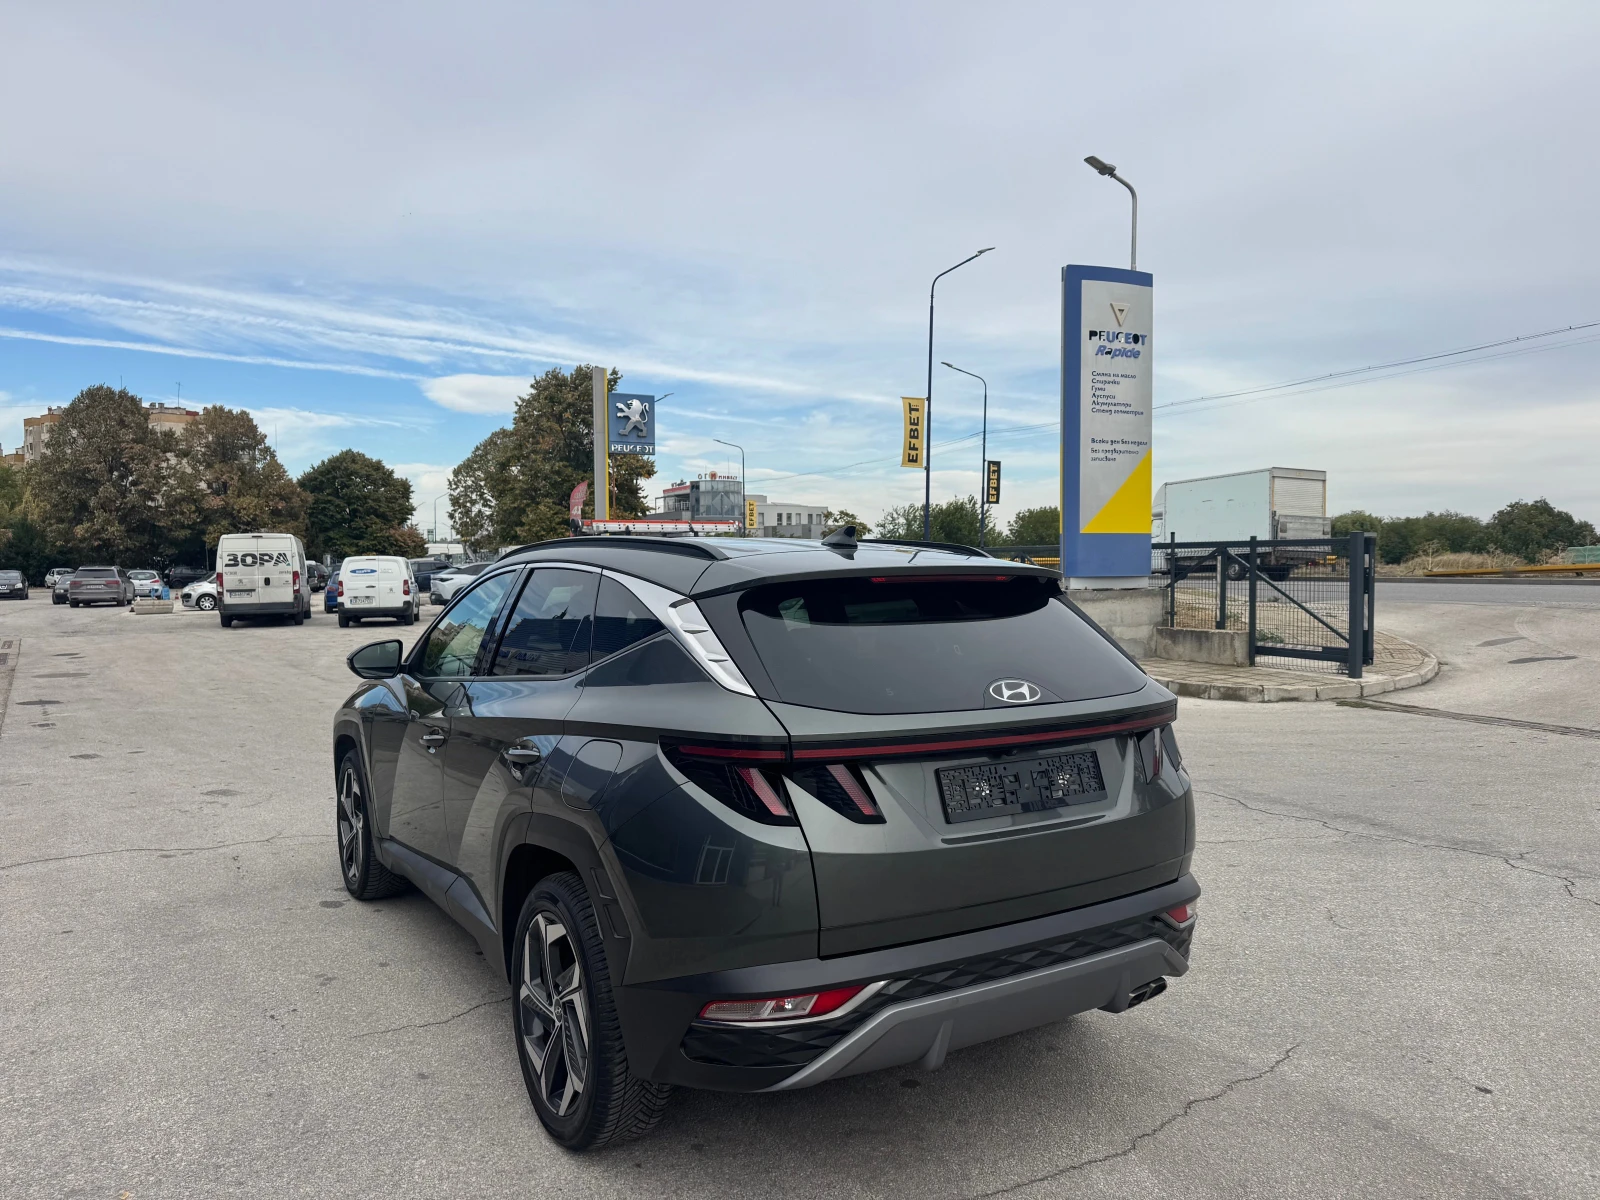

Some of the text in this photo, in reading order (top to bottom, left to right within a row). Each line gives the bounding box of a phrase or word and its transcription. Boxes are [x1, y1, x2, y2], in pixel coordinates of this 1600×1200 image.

[1088, 330, 1147, 346] PEUGEOT
[1095, 344, 1141, 359] Rapide
[1091, 370, 1112, 378] Смяна
[1091, 378, 1121, 386] Спирачки
[1091, 400, 1132, 408] Акумулатори
[907, 402, 920, 464] EFBET
[988, 463, 998, 502] EFBET
